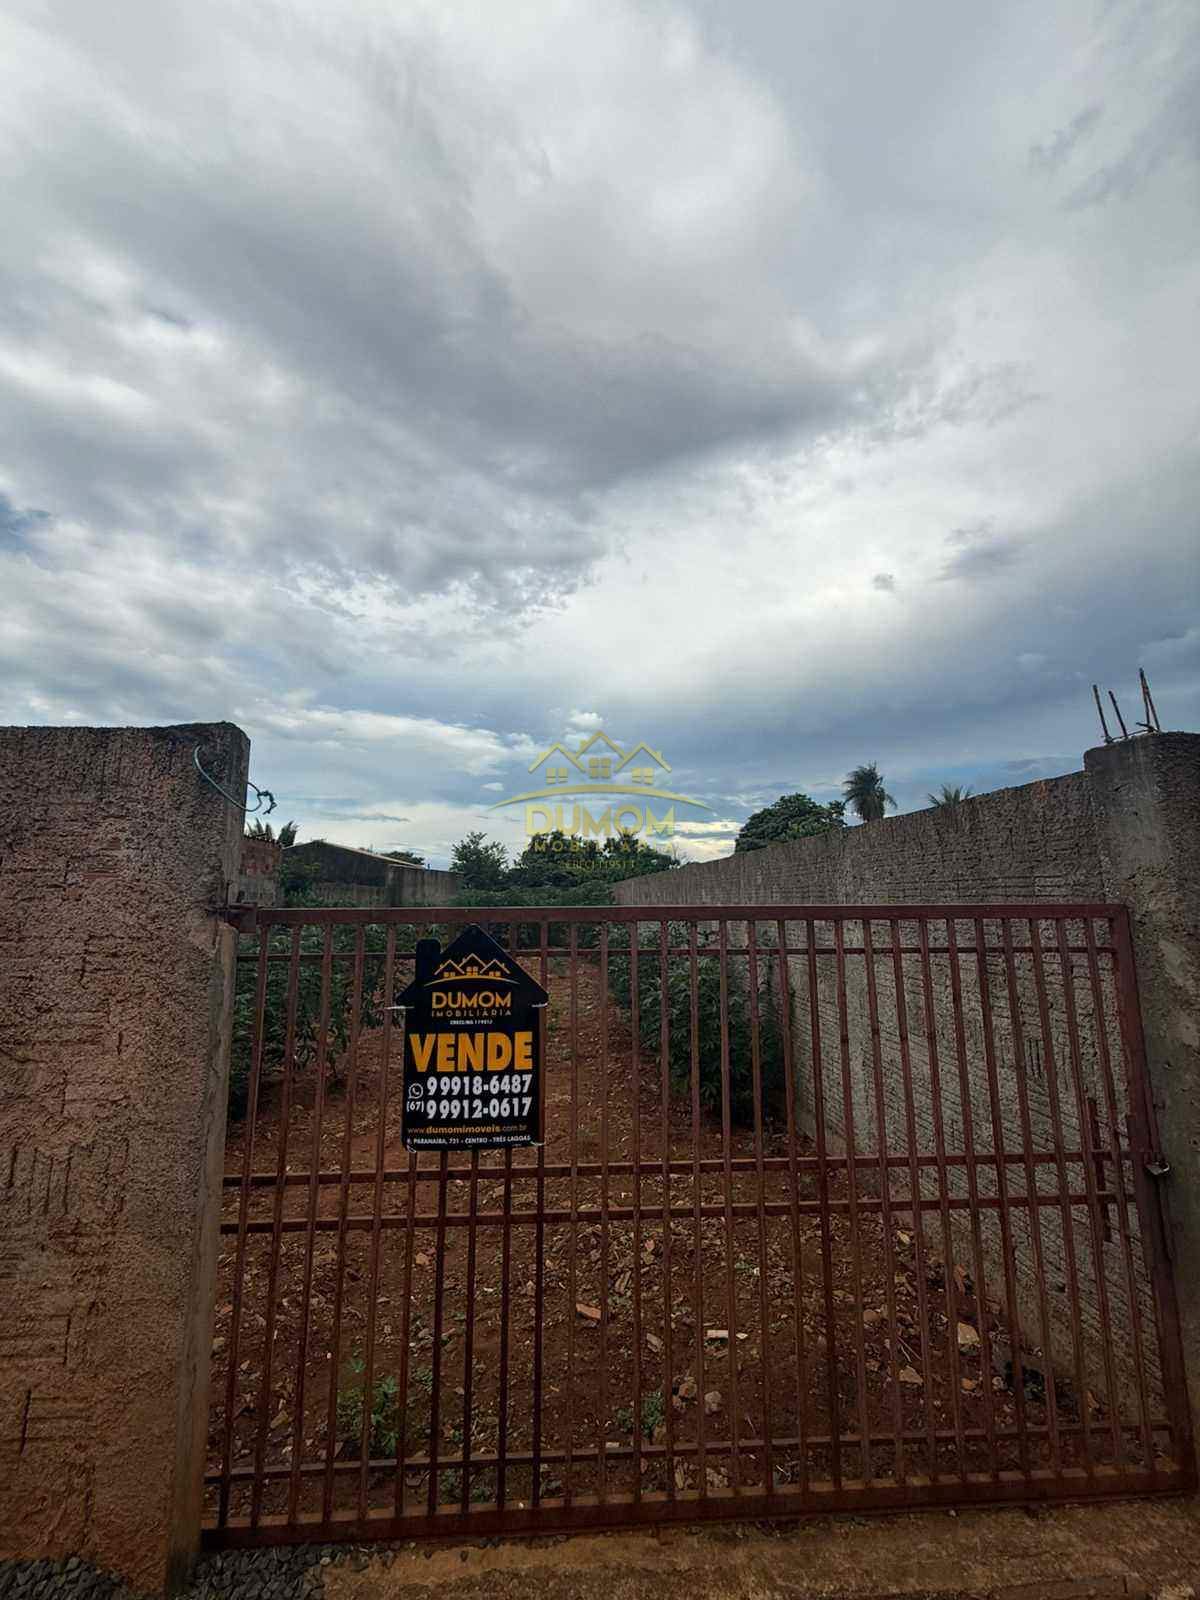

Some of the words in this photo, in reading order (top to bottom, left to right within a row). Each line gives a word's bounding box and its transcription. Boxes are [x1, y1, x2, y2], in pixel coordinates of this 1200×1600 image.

[431, 991, 512, 1008] DUMOM
[431, 1008, 512, 1018] IMOBILIÁRIA
[409, 1031, 533, 1072] VENDE
[426, 1074, 532, 1096] 99918-6487
[406, 1101, 424, 1113] (67)
[426, 1097, 532, 1119] 99912-0617
[407, 1124, 528, 1135] www.dumomimoveis.com.br
